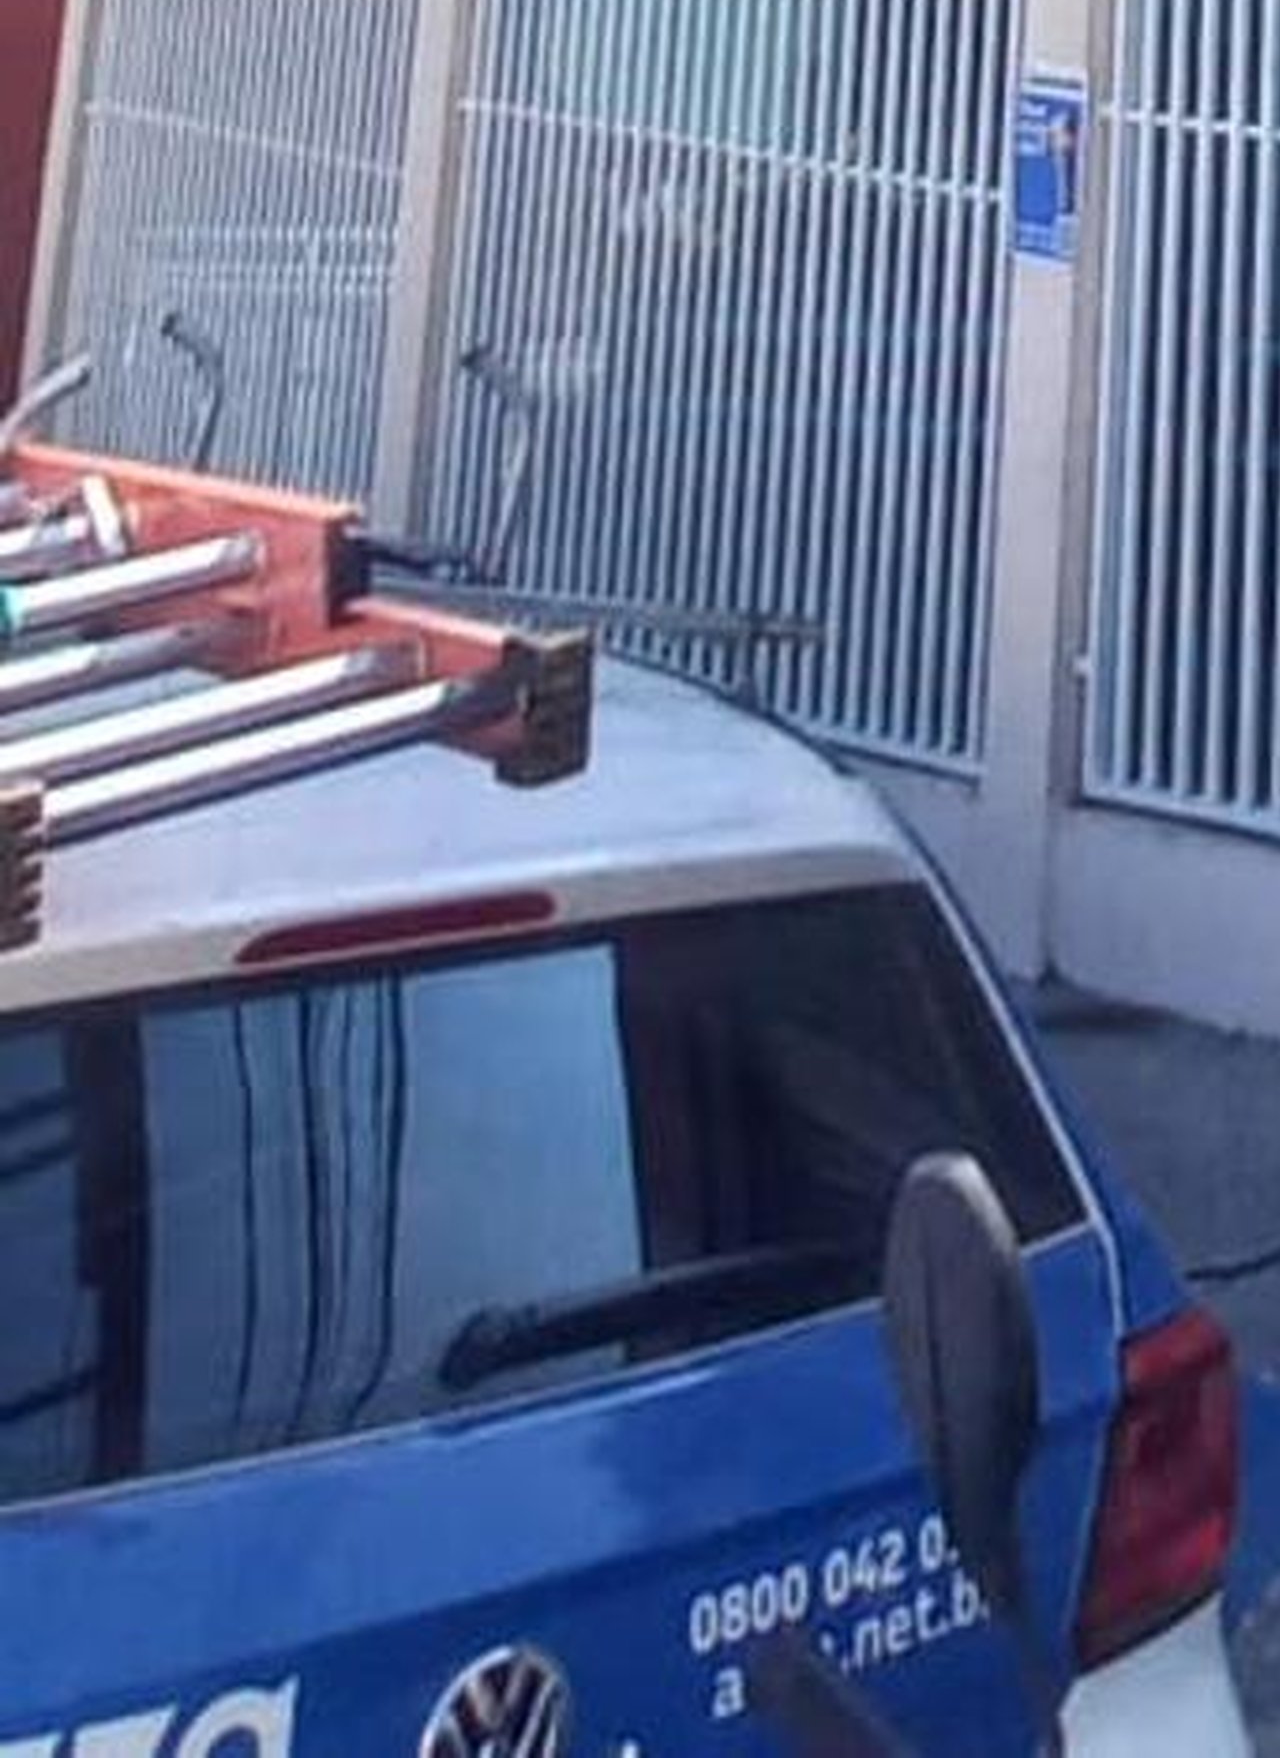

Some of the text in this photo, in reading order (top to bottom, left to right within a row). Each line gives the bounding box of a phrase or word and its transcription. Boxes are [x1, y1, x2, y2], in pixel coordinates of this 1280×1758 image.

[689, 1513, 960, 1654] 0800 042 0
